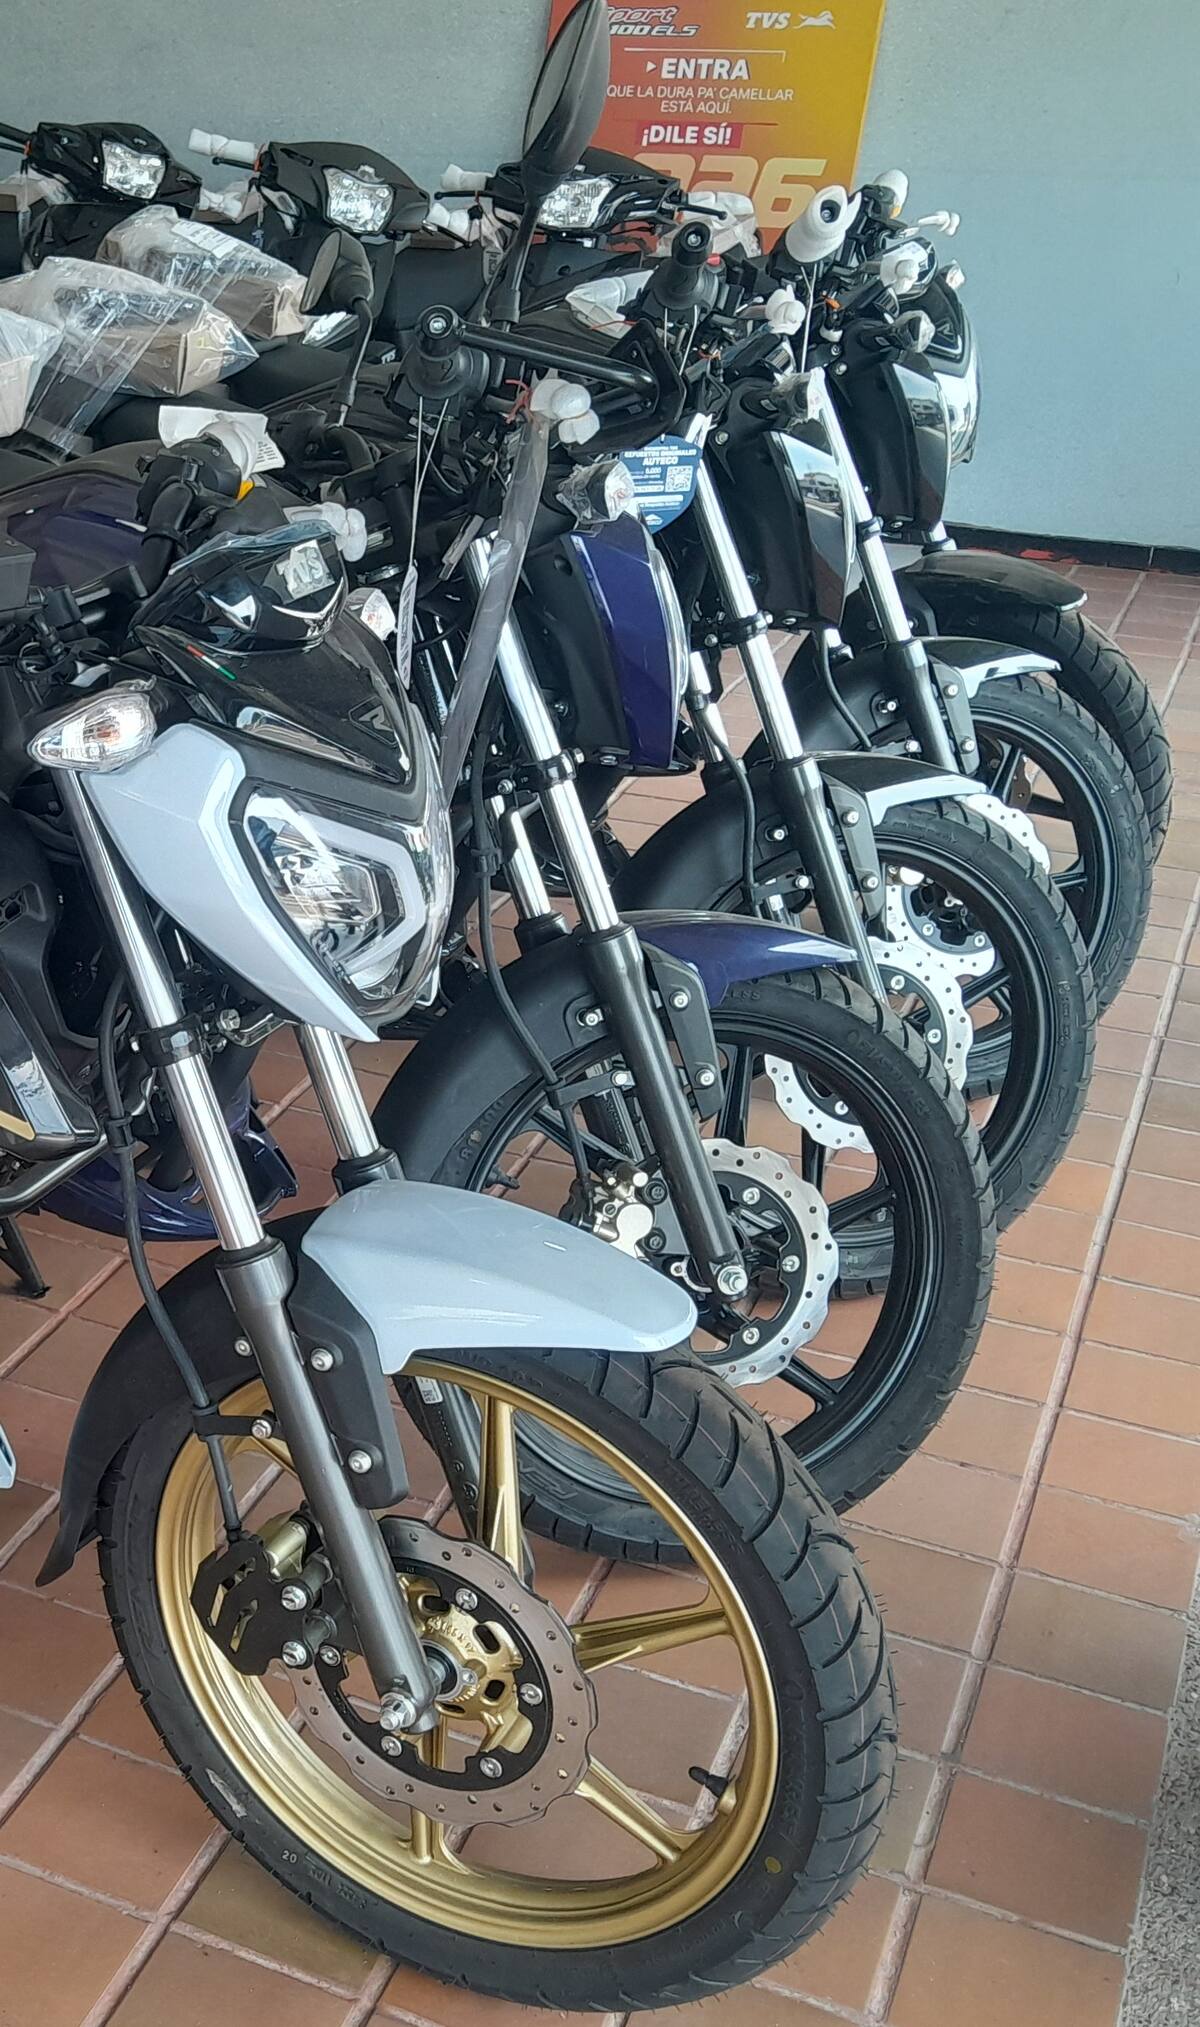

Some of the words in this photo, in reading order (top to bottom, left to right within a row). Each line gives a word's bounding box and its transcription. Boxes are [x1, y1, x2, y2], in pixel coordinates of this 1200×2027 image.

[745, 12, 791, 29] TVS
[661, 58, 749, 80] ENTRA
[607, 84, 635, 97] QUE
[637, 86, 654, 97] LA
[657, 86, 694, 98] DURA
[719, 87, 794, 101] CAMELLAR
[660, 99, 694, 113] ESTÁ
[696, 99, 732, 114] AQUÍ.
[641, 125, 699, 147] ¡DILE
[703, 122, 732, 145] SÍ!
[643, 457, 678, 466] AUTECO
[276, 549, 324, 588] TVS
[282, 1850, 297, 1864] 20
